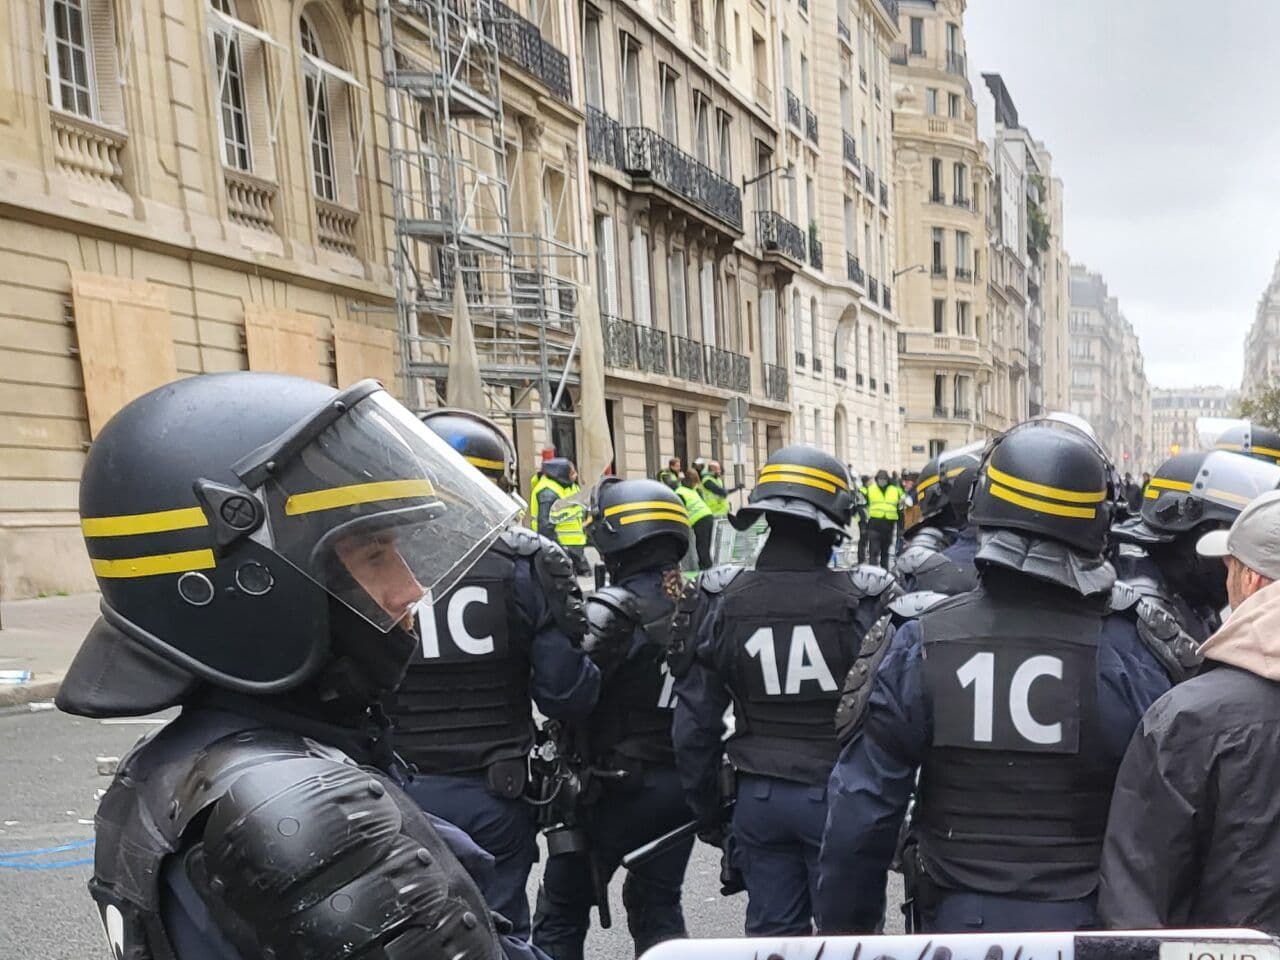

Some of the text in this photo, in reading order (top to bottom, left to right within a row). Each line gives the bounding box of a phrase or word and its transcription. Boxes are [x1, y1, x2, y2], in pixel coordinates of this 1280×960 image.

[407, 585, 495, 659] 1C
[744, 624, 839, 695] 1A
[955, 652, 1063, 744] 1C
